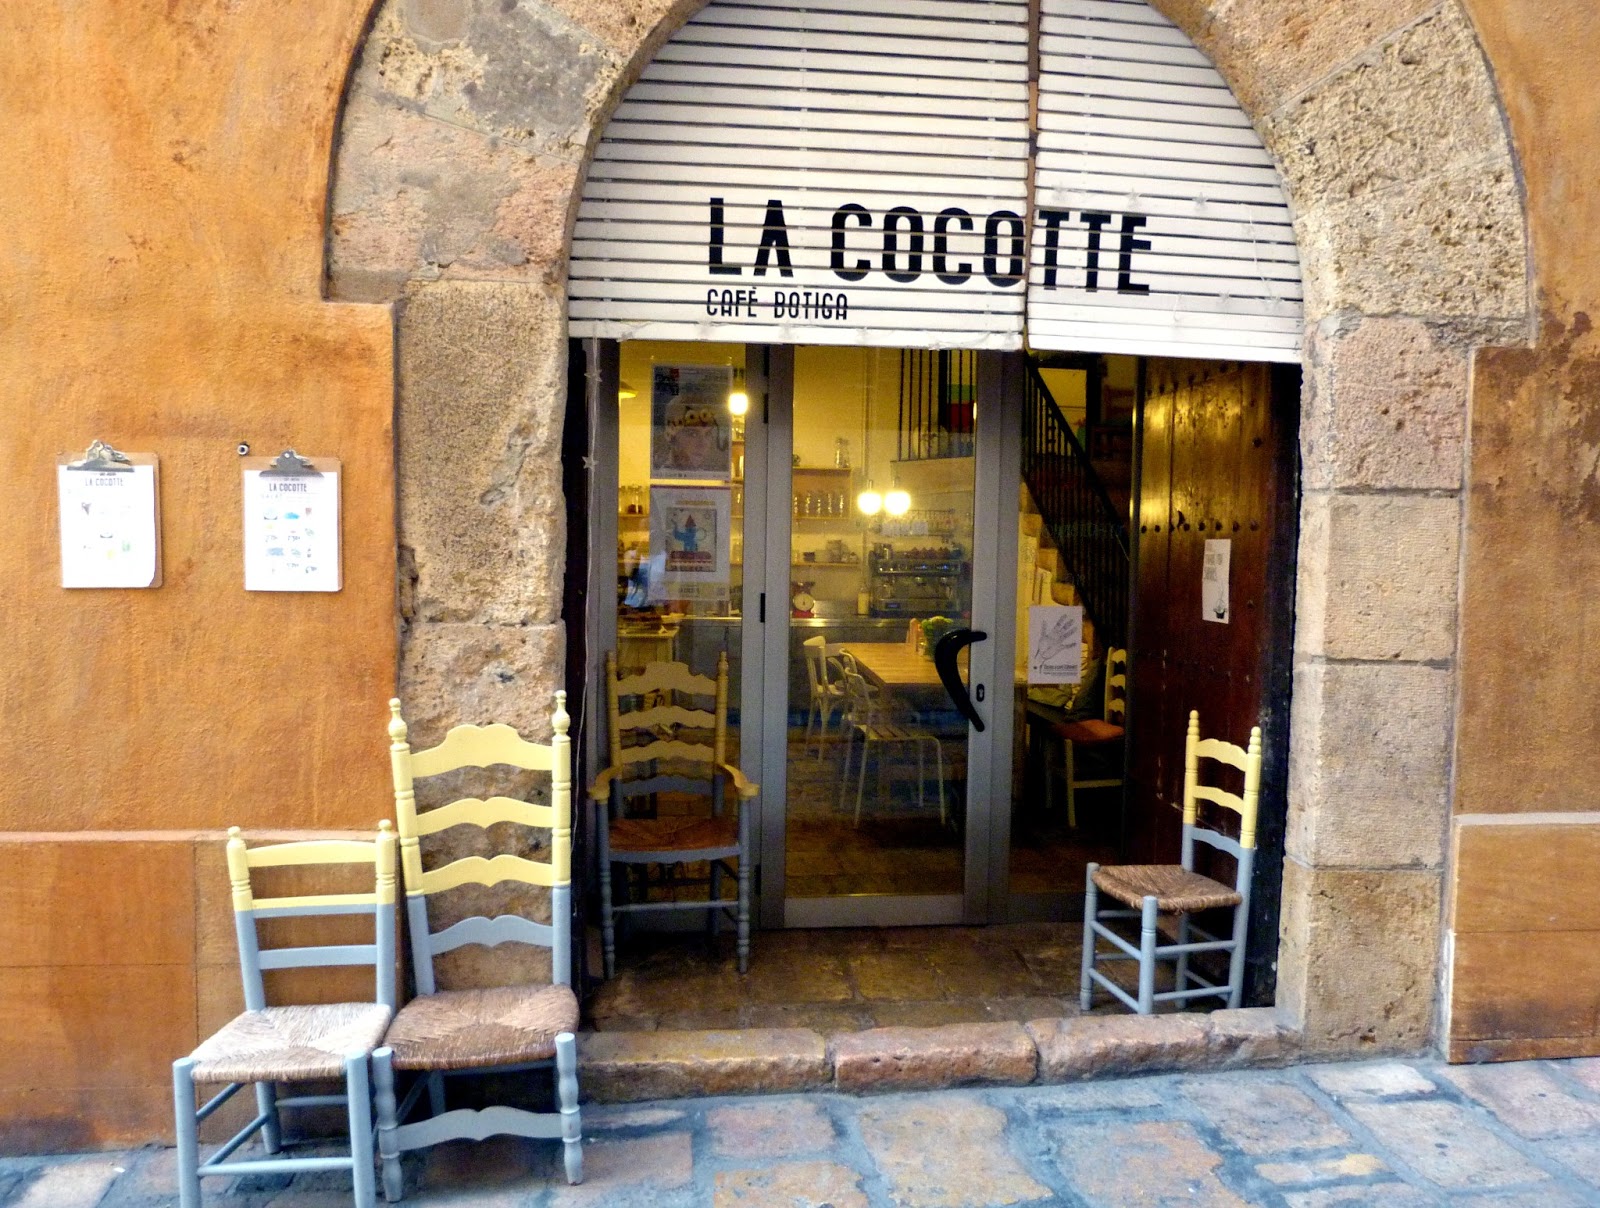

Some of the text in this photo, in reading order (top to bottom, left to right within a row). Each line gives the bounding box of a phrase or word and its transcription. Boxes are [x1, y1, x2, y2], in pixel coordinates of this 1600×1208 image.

[709, 197, 1152, 297] LA COCOTTE
[773, 290, 849, 321] BOTIGA
[269, 483, 307, 493] LA COCOTTE
